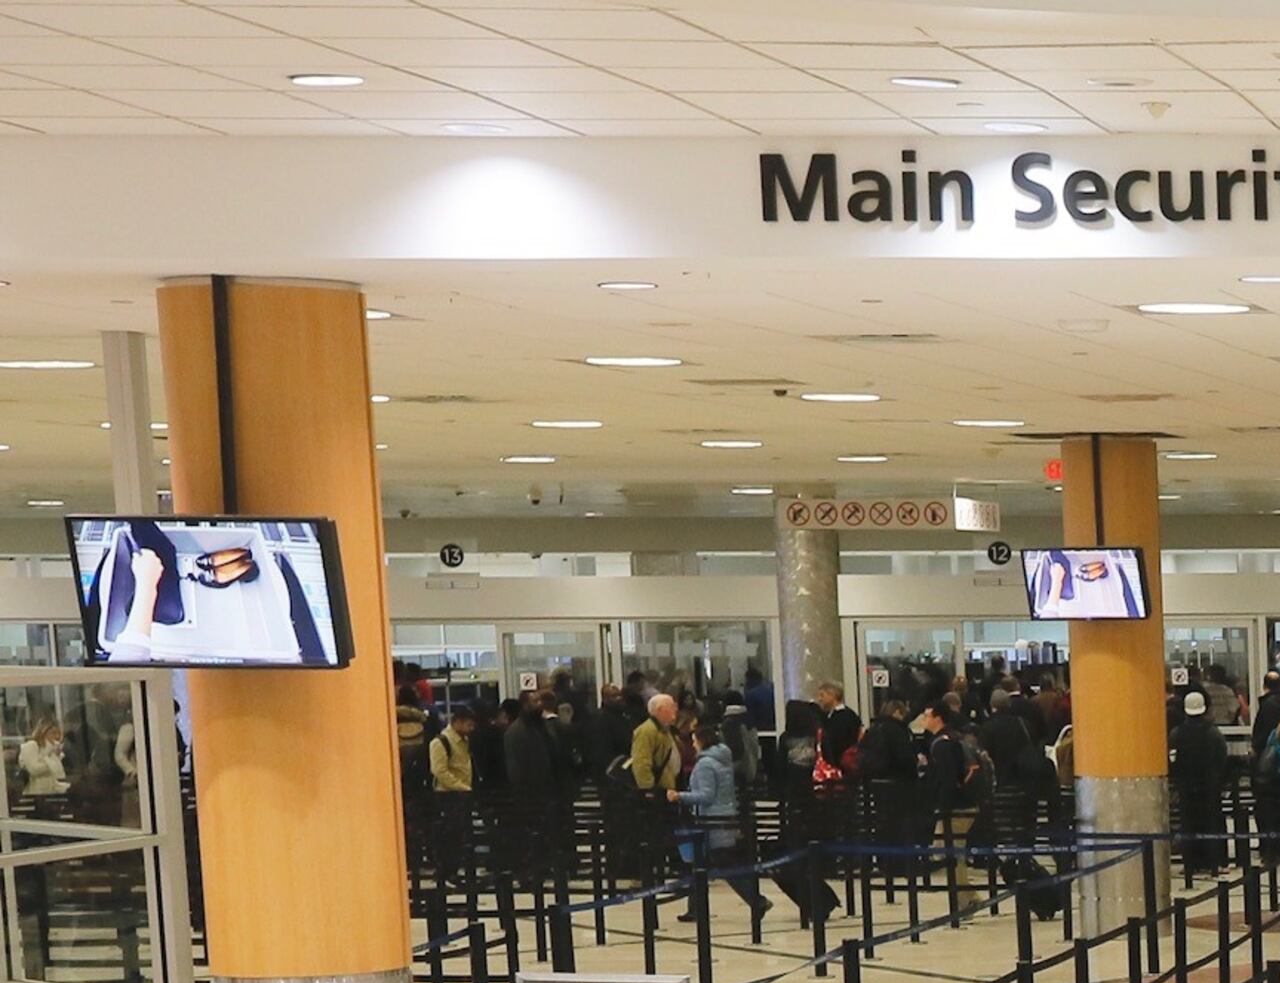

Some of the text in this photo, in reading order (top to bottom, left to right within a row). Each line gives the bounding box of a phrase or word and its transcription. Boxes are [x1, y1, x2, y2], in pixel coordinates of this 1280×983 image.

[759, 149, 975, 223] Main
[443, 546, 462, 563] 13
[991, 547, 1008, 560] 12
